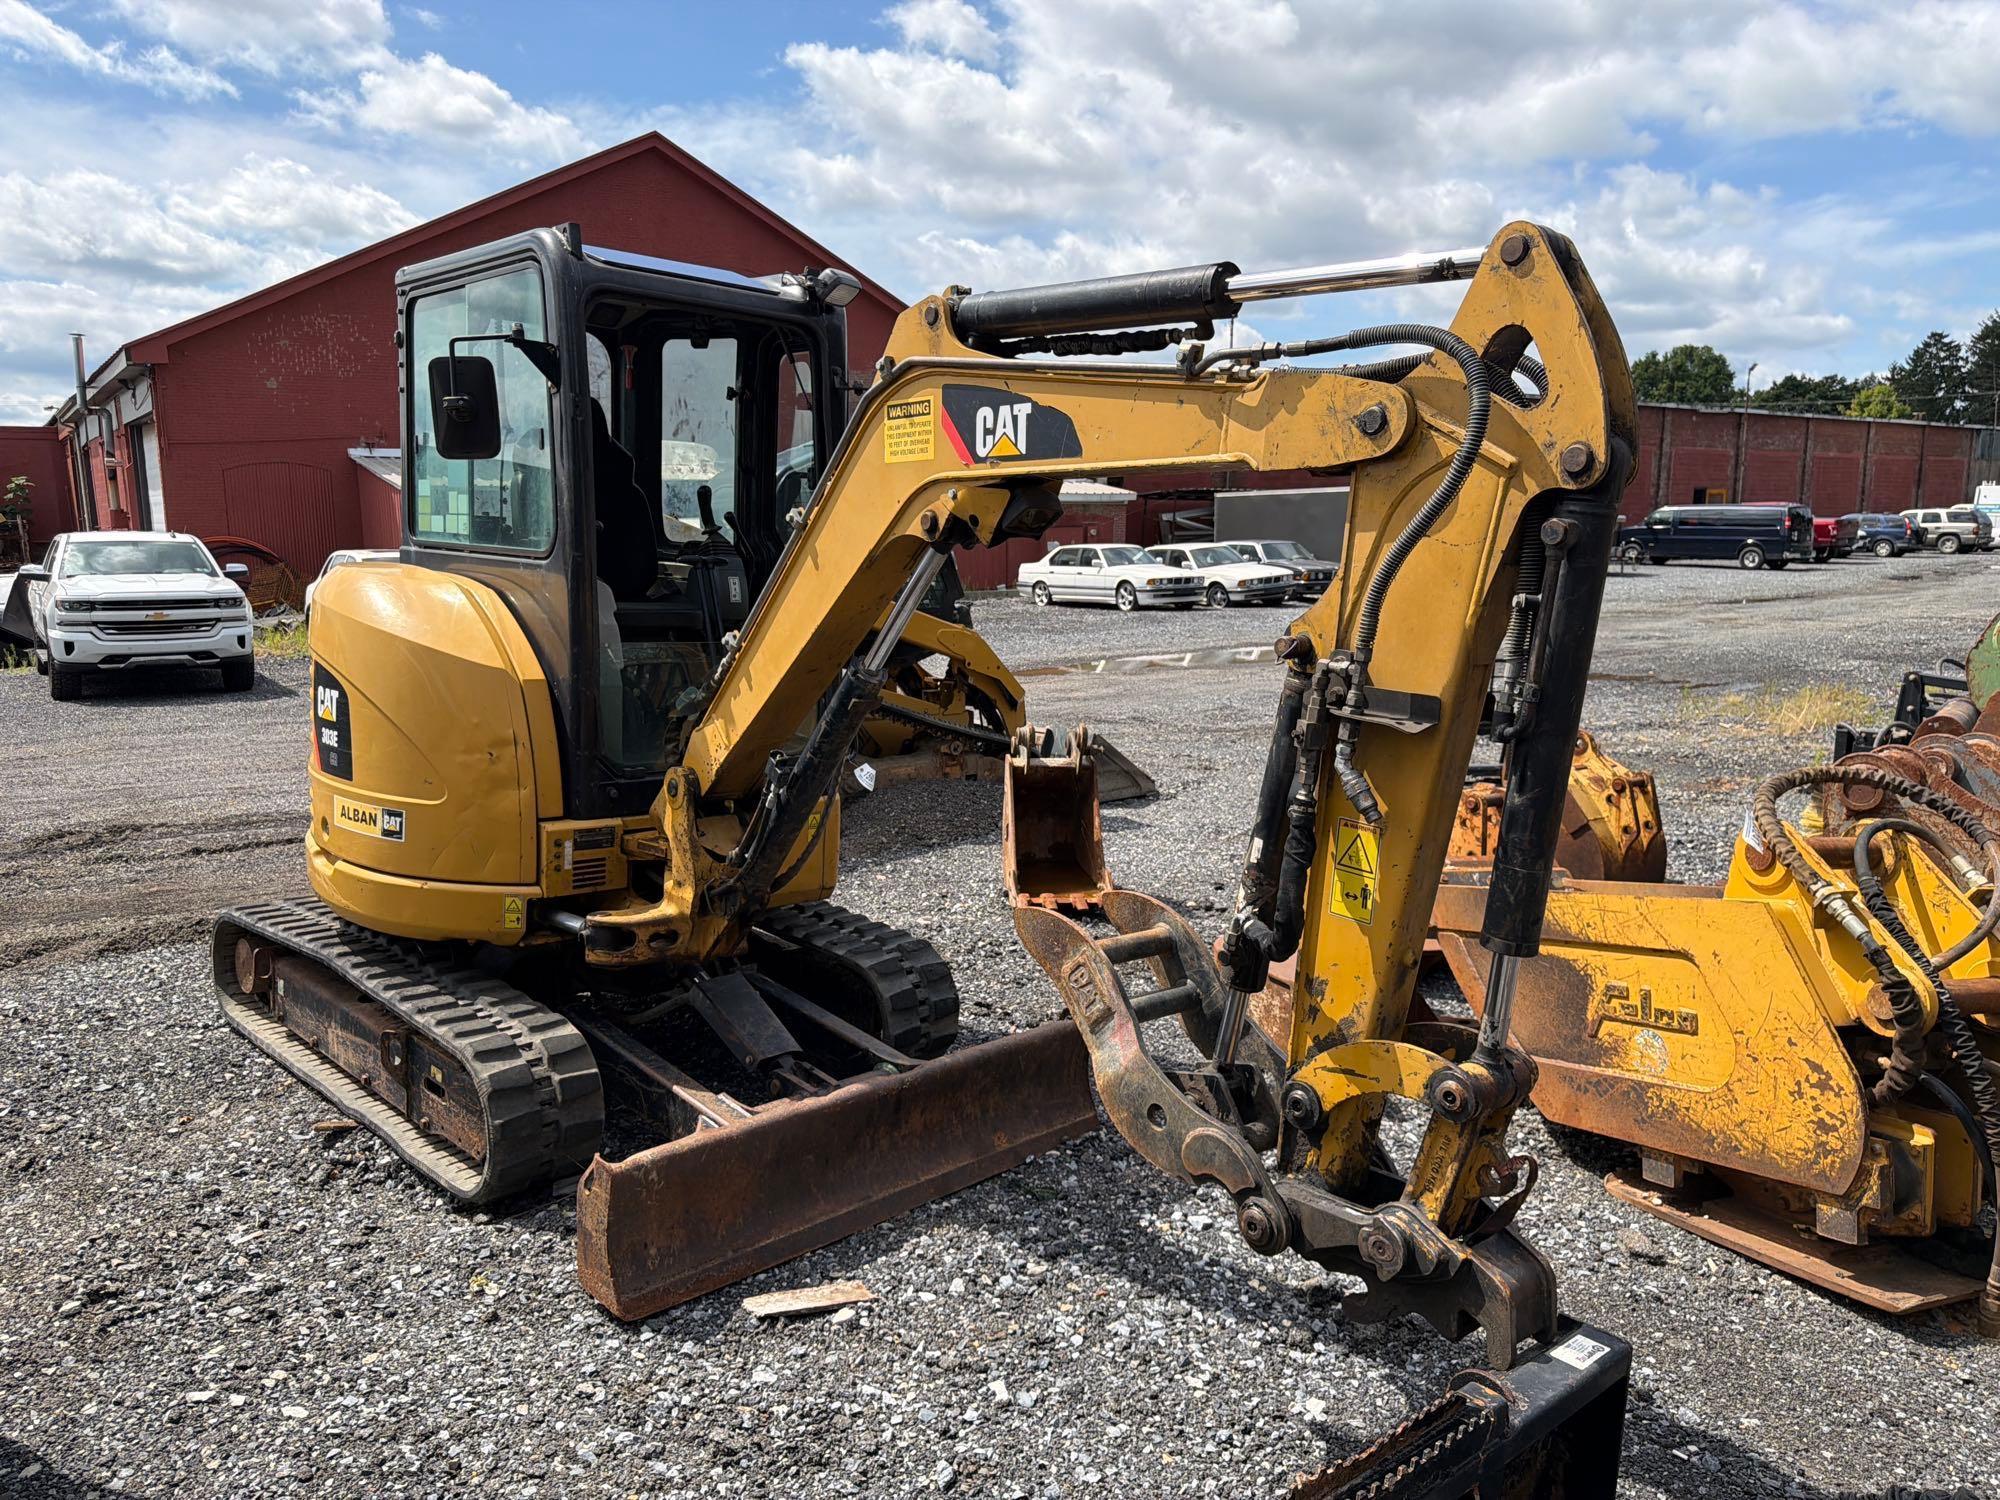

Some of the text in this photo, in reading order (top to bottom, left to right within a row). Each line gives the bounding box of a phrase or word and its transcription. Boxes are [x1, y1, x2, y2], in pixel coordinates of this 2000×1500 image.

[888, 403, 930, 418] WARNING
[975, 402, 1032, 458] CAT
[317, 685, 339, 723] CAT
[321, 726, 339, 748] 303E
[340, 804, 403, 832] ALBAN CAT
